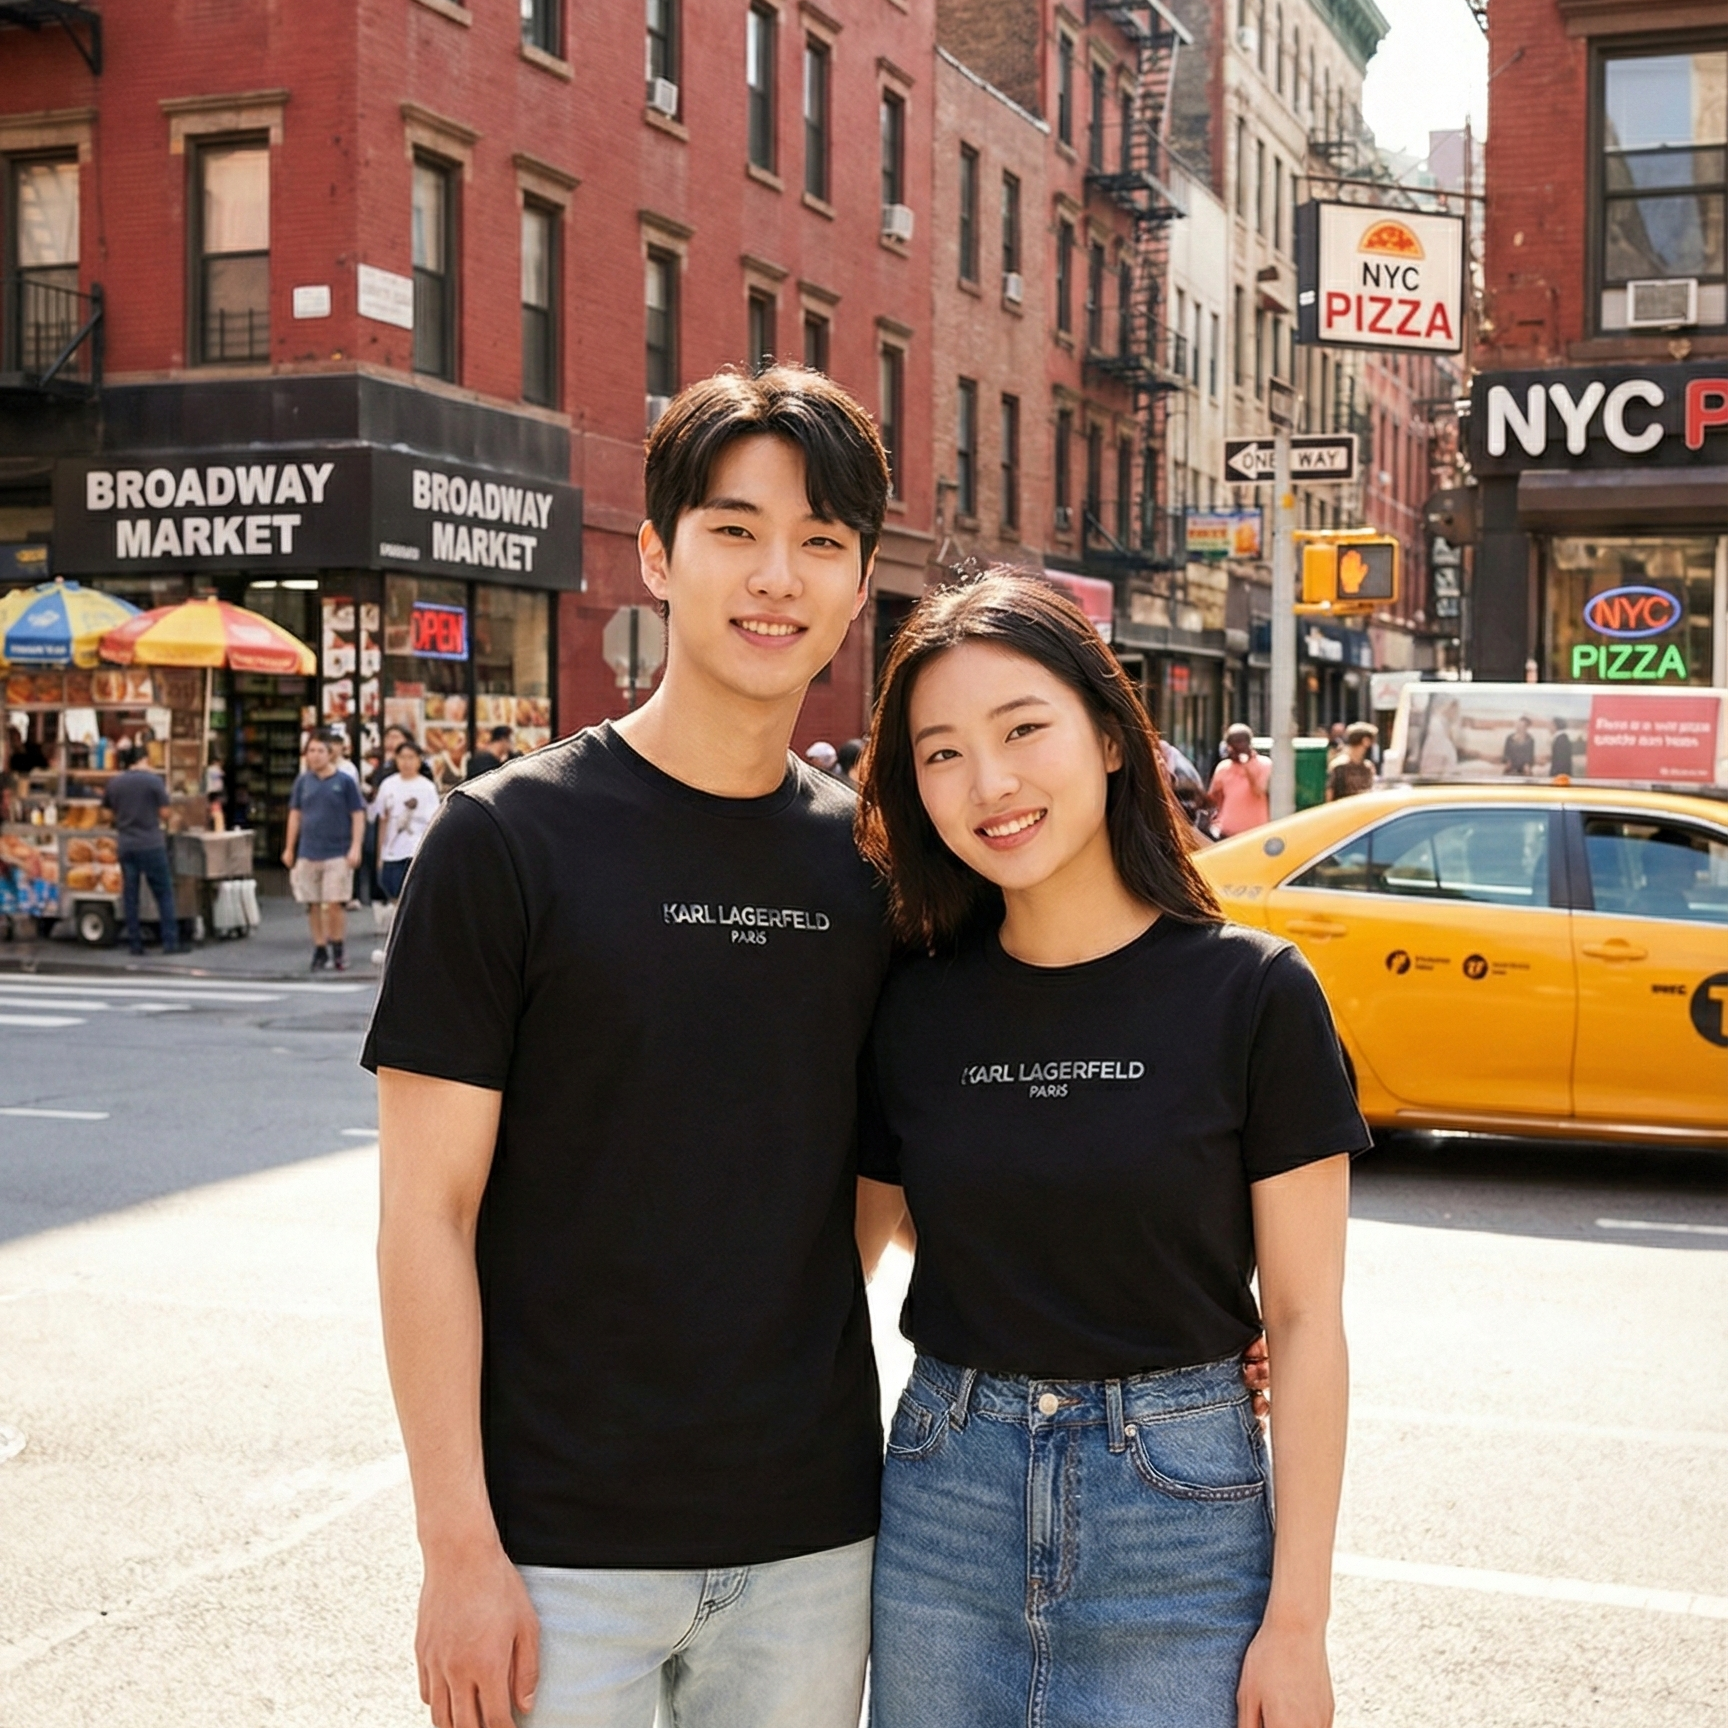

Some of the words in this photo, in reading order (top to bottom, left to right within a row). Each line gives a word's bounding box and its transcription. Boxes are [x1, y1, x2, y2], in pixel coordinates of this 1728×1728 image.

[1362, 261, 1420, 291] NYC
[1326, 292, 1453, 340] PIZZA
[1487, 379, 1665, 457] NYC
[1299, 451, 1339, 468] WAY
[86, 463, 334, 510] BROADWAY
[412, 469, 553, 529] BROADWAY
[116, 514, 302, 559] MARKET
[432, 521, 537, 572] MARKET
[1593, 596, 1670, 630] NYC
[411, 610, 463, 654] OPEN
[1572, 644, 1687, 680] PIZZA
[663, 903, 717, 924] KARL
[718, 905, 831, 931] LAGERFELD
[731, 930, 767, 945] PARIS
[961, 1064, 1014, 1086] KARL
[1018, 1061, 1145, 1082] LAGERFELD
[1029, 1084, 1068, 1098] PARIS
